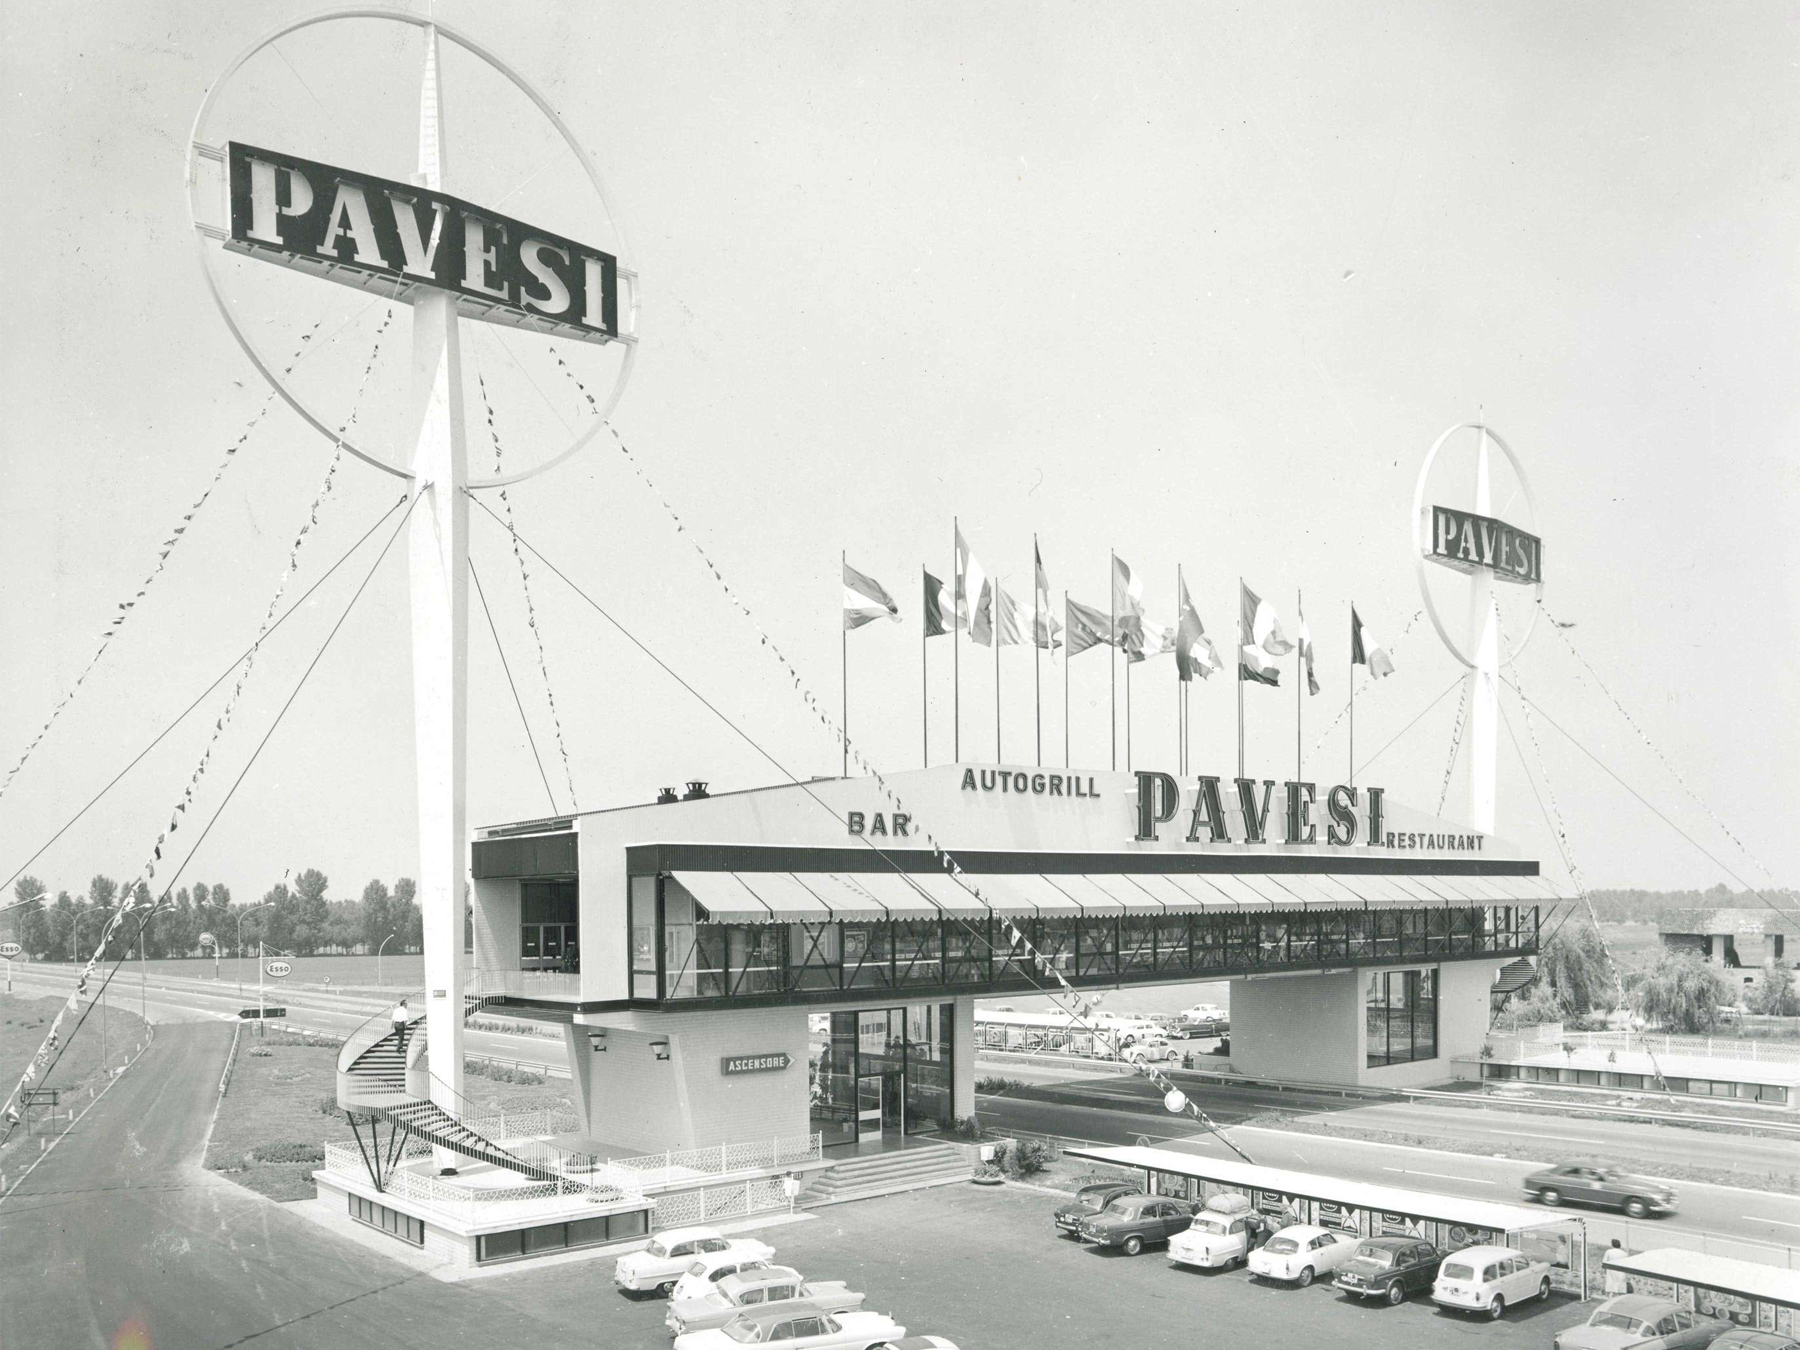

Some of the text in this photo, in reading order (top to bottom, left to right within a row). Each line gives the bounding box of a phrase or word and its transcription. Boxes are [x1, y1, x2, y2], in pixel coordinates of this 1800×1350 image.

[244, 156, 608, 331] PAVESI
[1436, 510, 1539, 580] PAVESI
[848, 811, 909, 837] BAR
[961, 768, 1385, 847] AUTOGRILL PAVESI
[1386, 831, 1484, 851] RESTAURANT
[728, 1056, 785, 1072] ASCENSORE
